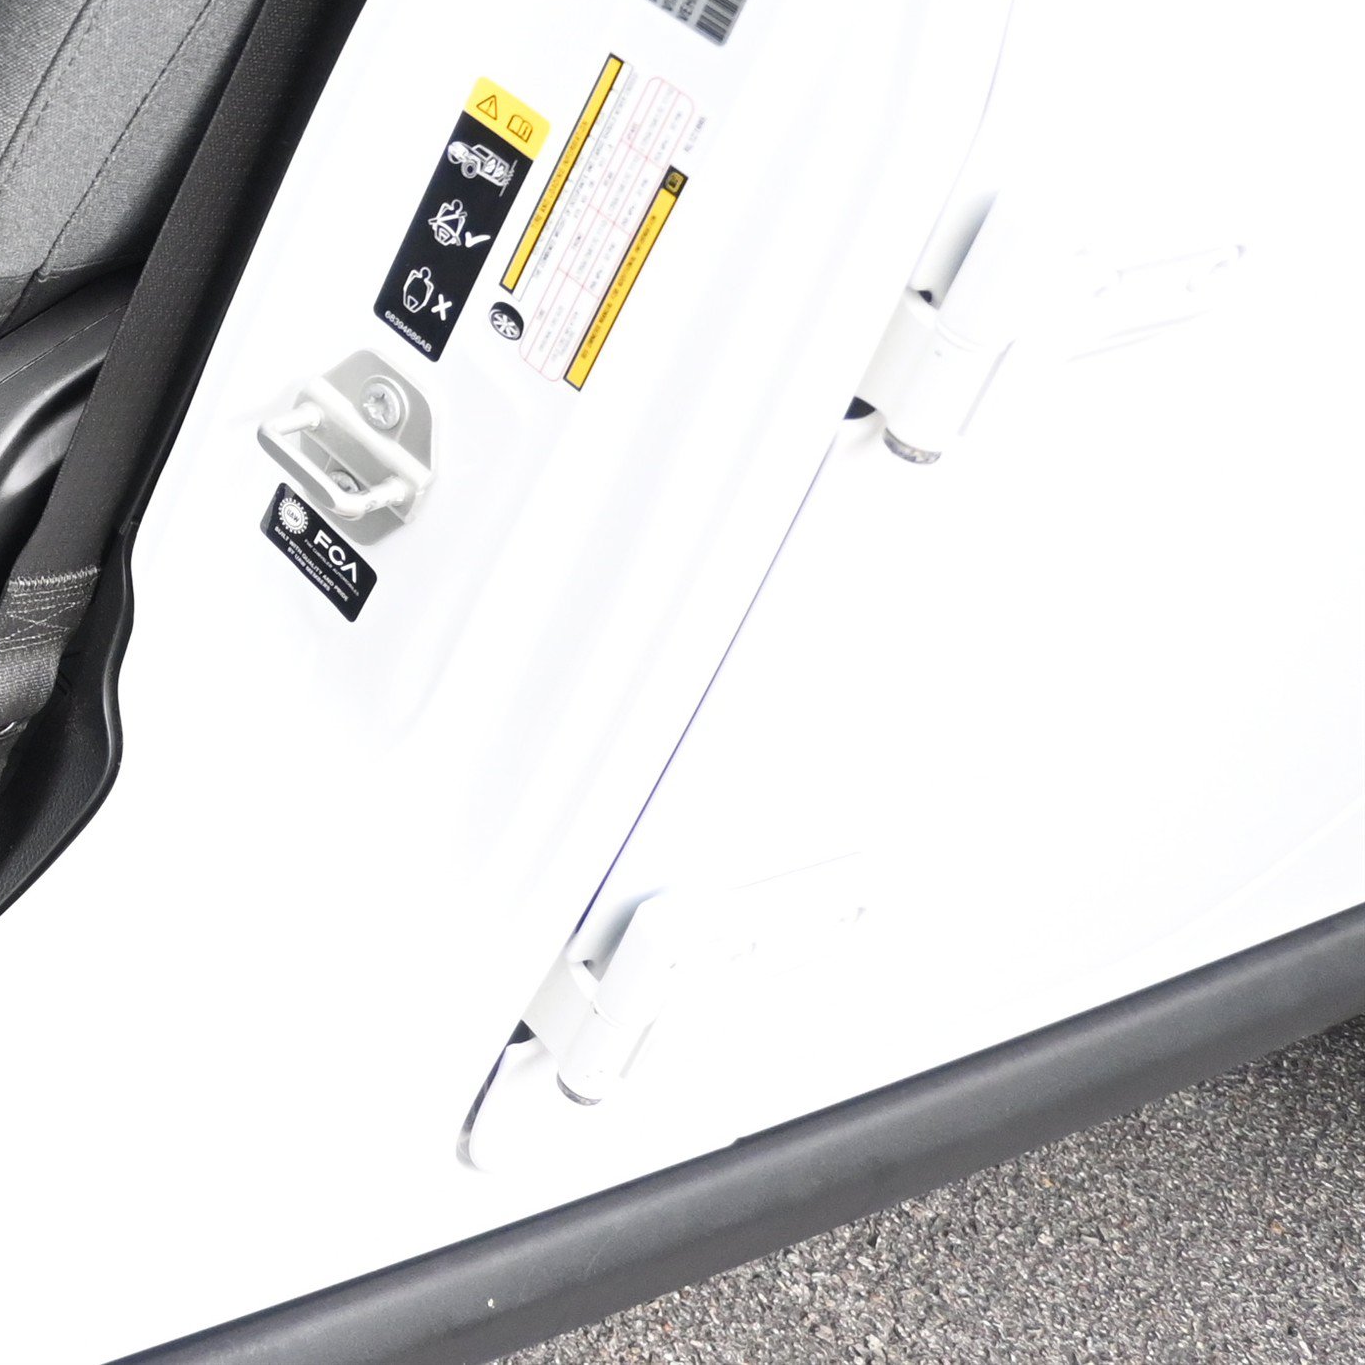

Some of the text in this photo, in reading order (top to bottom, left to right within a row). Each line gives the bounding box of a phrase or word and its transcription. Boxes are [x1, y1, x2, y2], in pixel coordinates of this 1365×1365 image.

[274, 526, 289, 541] BUILT
[287, 539, 303, 555] WITH
[300, 552, 323, 575] QUALITY
[321, 573, 334, 587] AND
[286, 546, 331, 592] BY UAW MEMBERS
[314, 529, 357, 583] FCA
